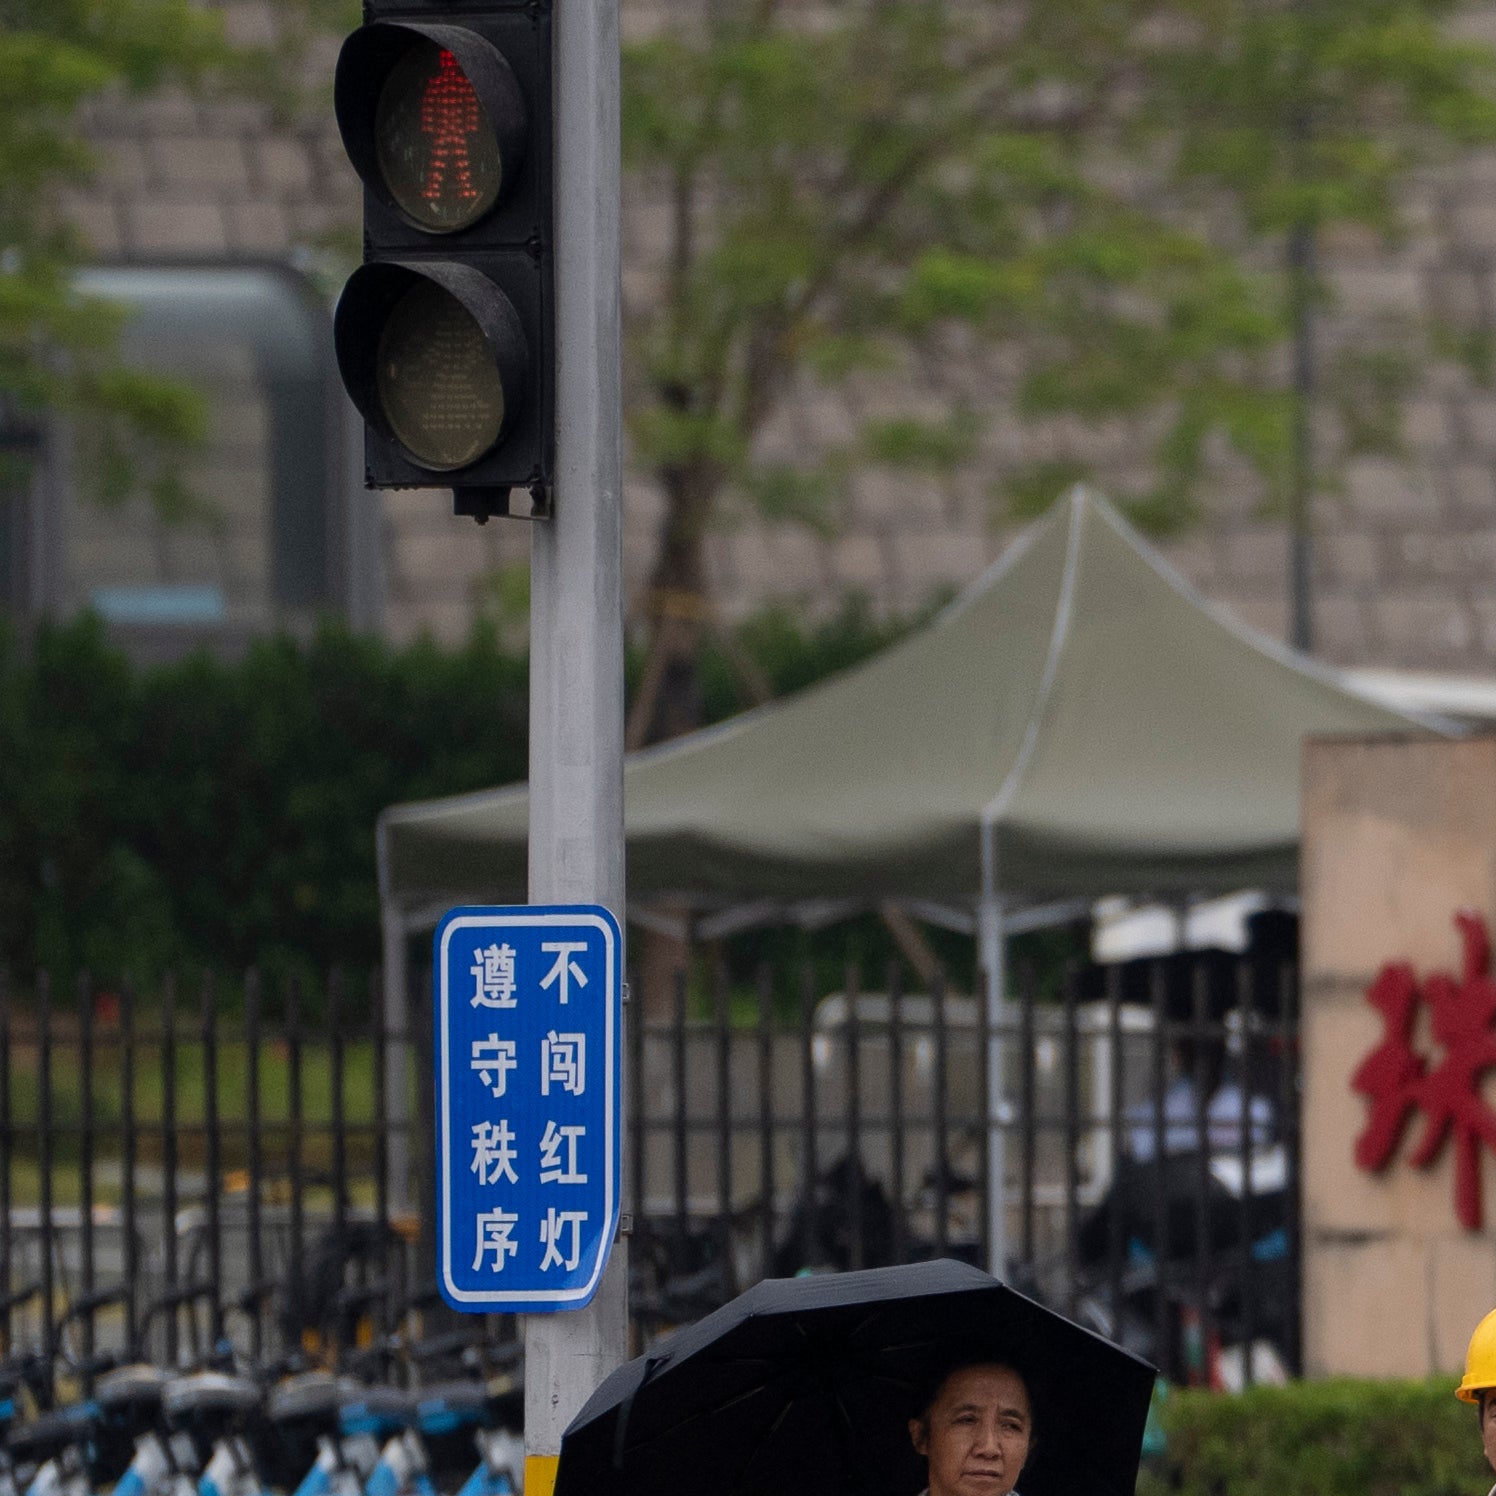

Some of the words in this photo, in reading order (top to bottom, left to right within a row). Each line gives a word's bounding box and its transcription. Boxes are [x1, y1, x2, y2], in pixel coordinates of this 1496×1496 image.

[470, 943, 519, 1273] 遵守秩序
[539, 941, 589, 1273] 不闯红灯
